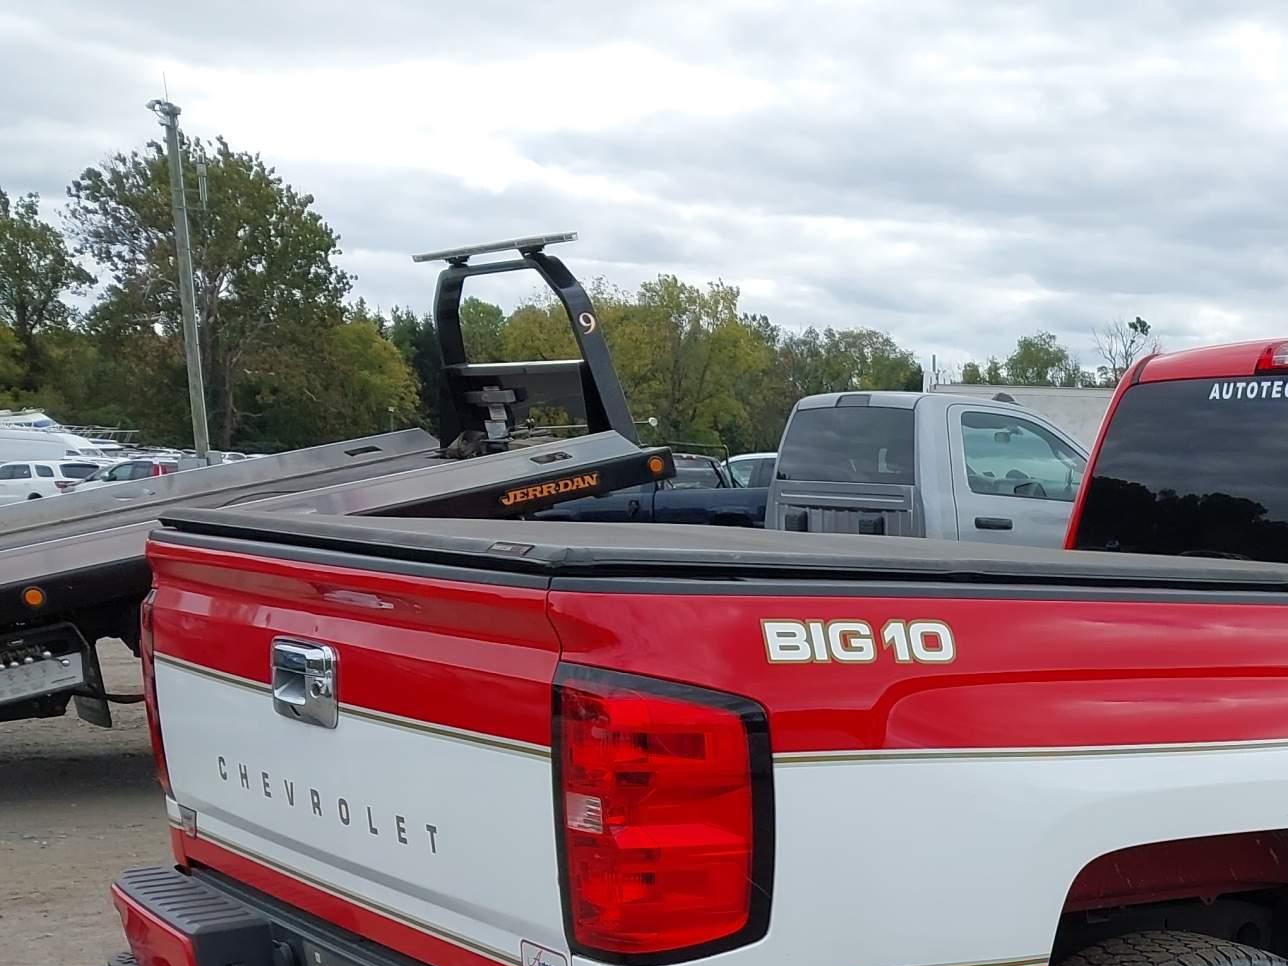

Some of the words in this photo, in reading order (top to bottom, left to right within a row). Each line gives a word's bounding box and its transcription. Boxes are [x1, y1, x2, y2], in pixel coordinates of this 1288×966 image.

[579, 312, 595, 335] 9
[760, 618, 878, 664] BIG
[880, 618, 957, 664] 10
[218, 755, 438, 854] CHEVROLET
